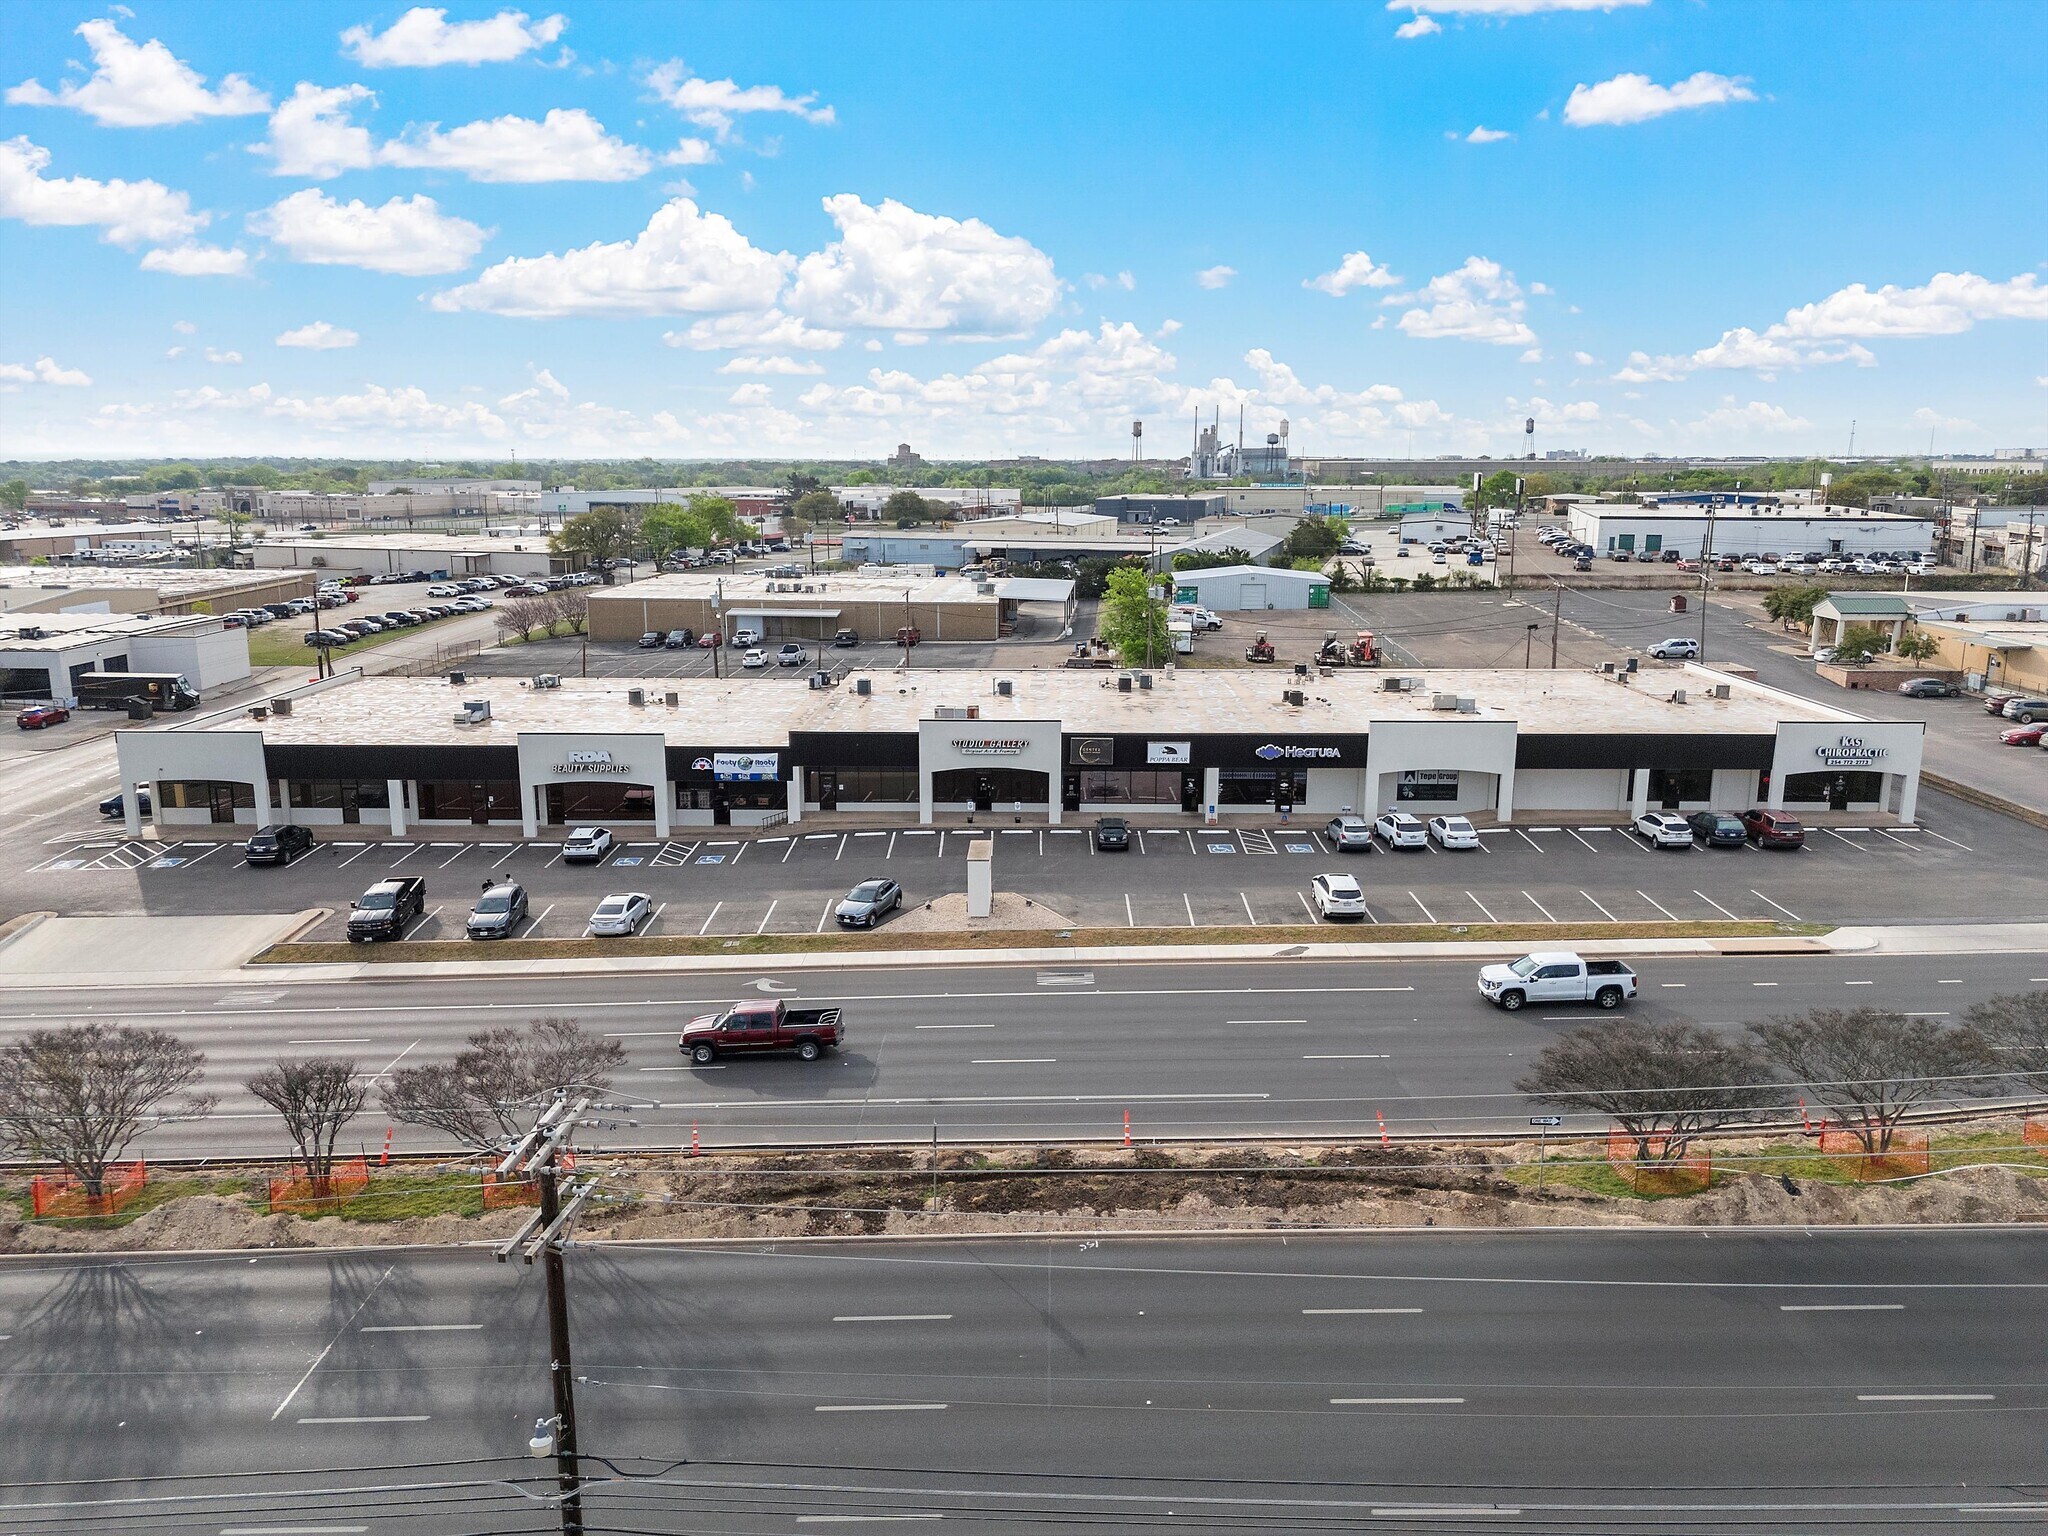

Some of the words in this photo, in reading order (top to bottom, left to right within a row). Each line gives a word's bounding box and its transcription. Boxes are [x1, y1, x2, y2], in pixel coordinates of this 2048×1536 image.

[952, 739, 985, 748] STUDIO
[989, 739, 1029, 748] GALLERY
[1817, 746, 1888, 757] CHIROPRACTIC
[716, 759, 737, 767] Footy
[754, 759, 776, 767] Rooty
[551, 764, 585, 773] BEAUTY
[587, 764, 629, 773] SUPPLIES
